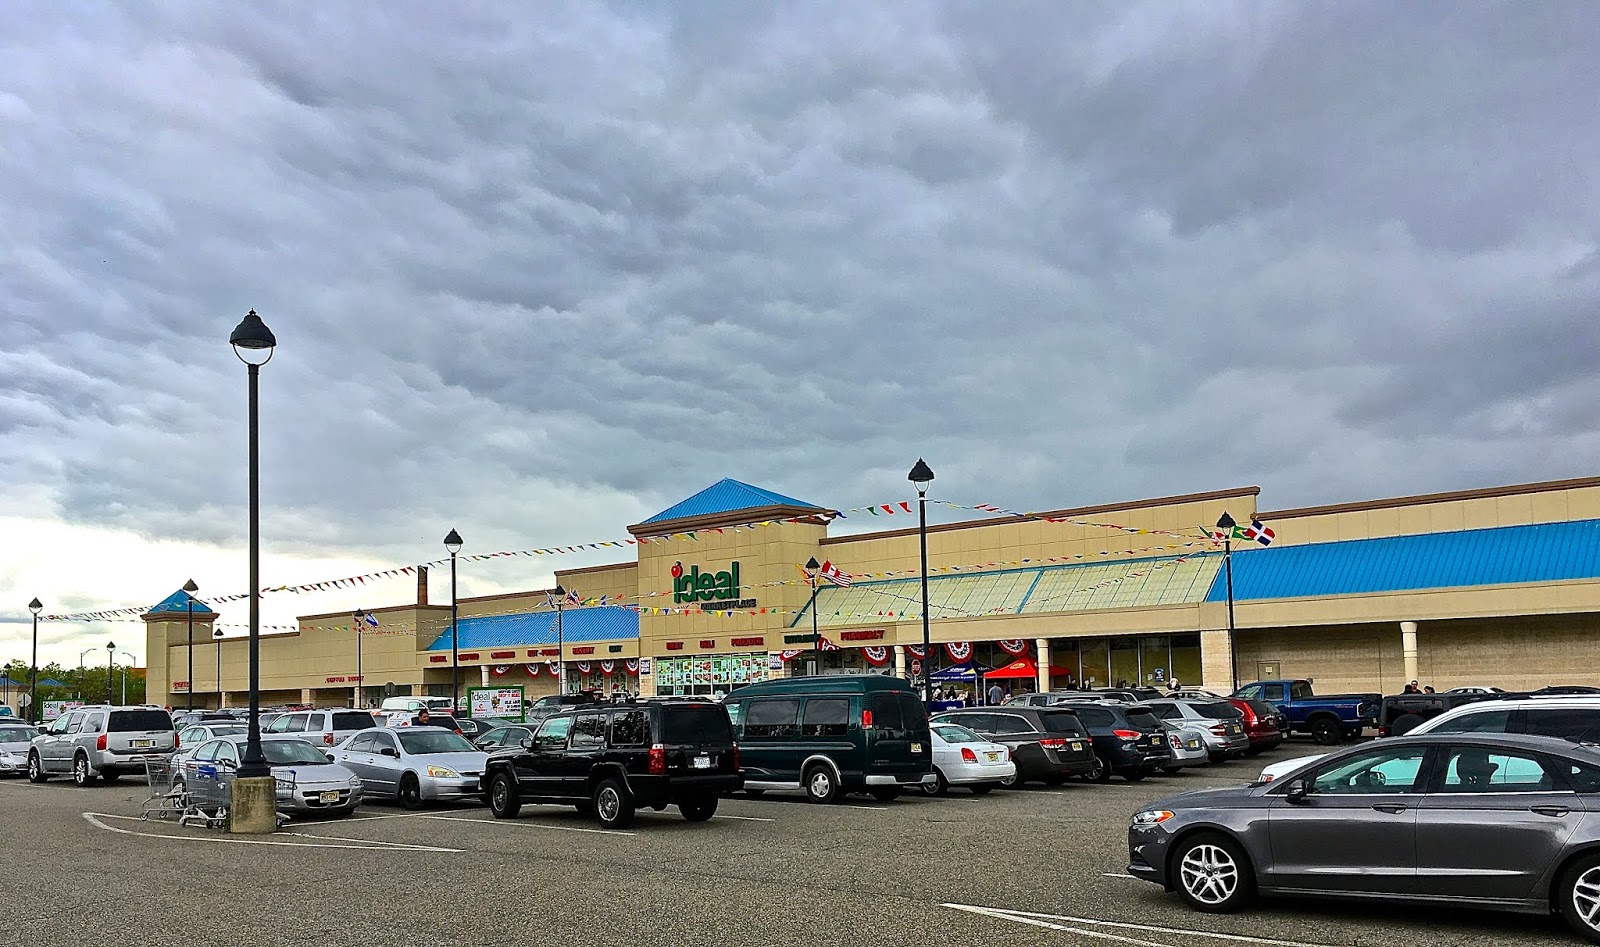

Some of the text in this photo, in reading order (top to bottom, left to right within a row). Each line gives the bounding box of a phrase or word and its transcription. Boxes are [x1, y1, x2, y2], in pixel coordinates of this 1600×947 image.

[671, 561, 740, 603] ideal
[701, 599, 757, 611] MARKETPLACE
[840, 630, 885, 641] PHARMACY
[731, 637, 764, 647] PRODUCE
[471, 691, 490, 701] ideal
